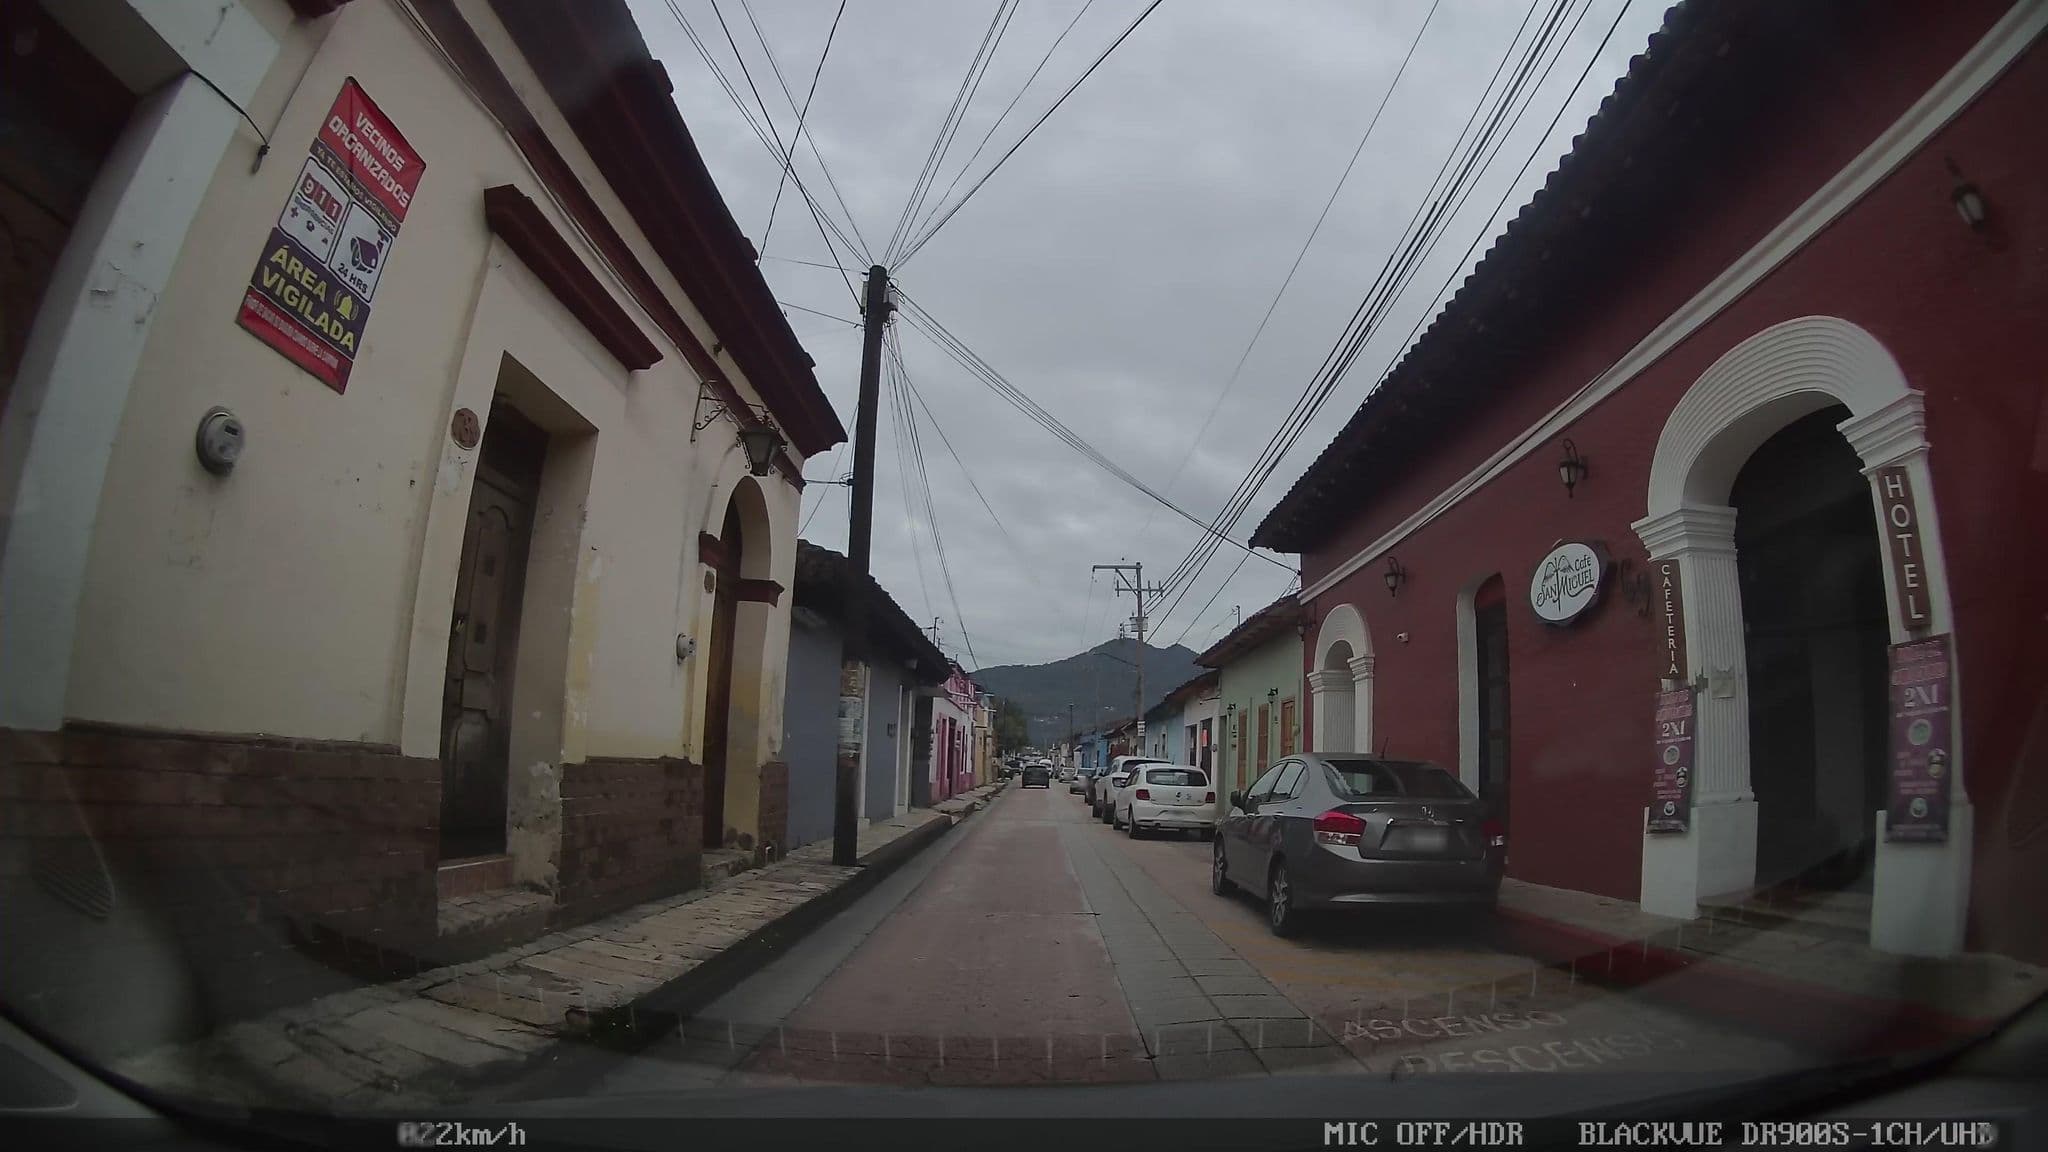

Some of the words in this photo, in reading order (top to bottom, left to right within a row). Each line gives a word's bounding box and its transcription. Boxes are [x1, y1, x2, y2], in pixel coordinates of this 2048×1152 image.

[328, 115, 411, 209] ORGANIZADOS
[355, 112, 406, 173] VECINOS
[304, 179, 342, 220] 911
[270, 245, 328, 302] ÁREA
[338, 262, 349, 279] 24
[348, 272, 368, 294] HRS
[262, 267, 355, 351] VIGILADA
[1884, 474, 1924, 620] HOTEL
[1661, 564, 1678, 675] CAFETERIA
[1342, 1009, 1568, 1044] ASCENSO
[1400, 1030, 1686, 1072] DESCENS
